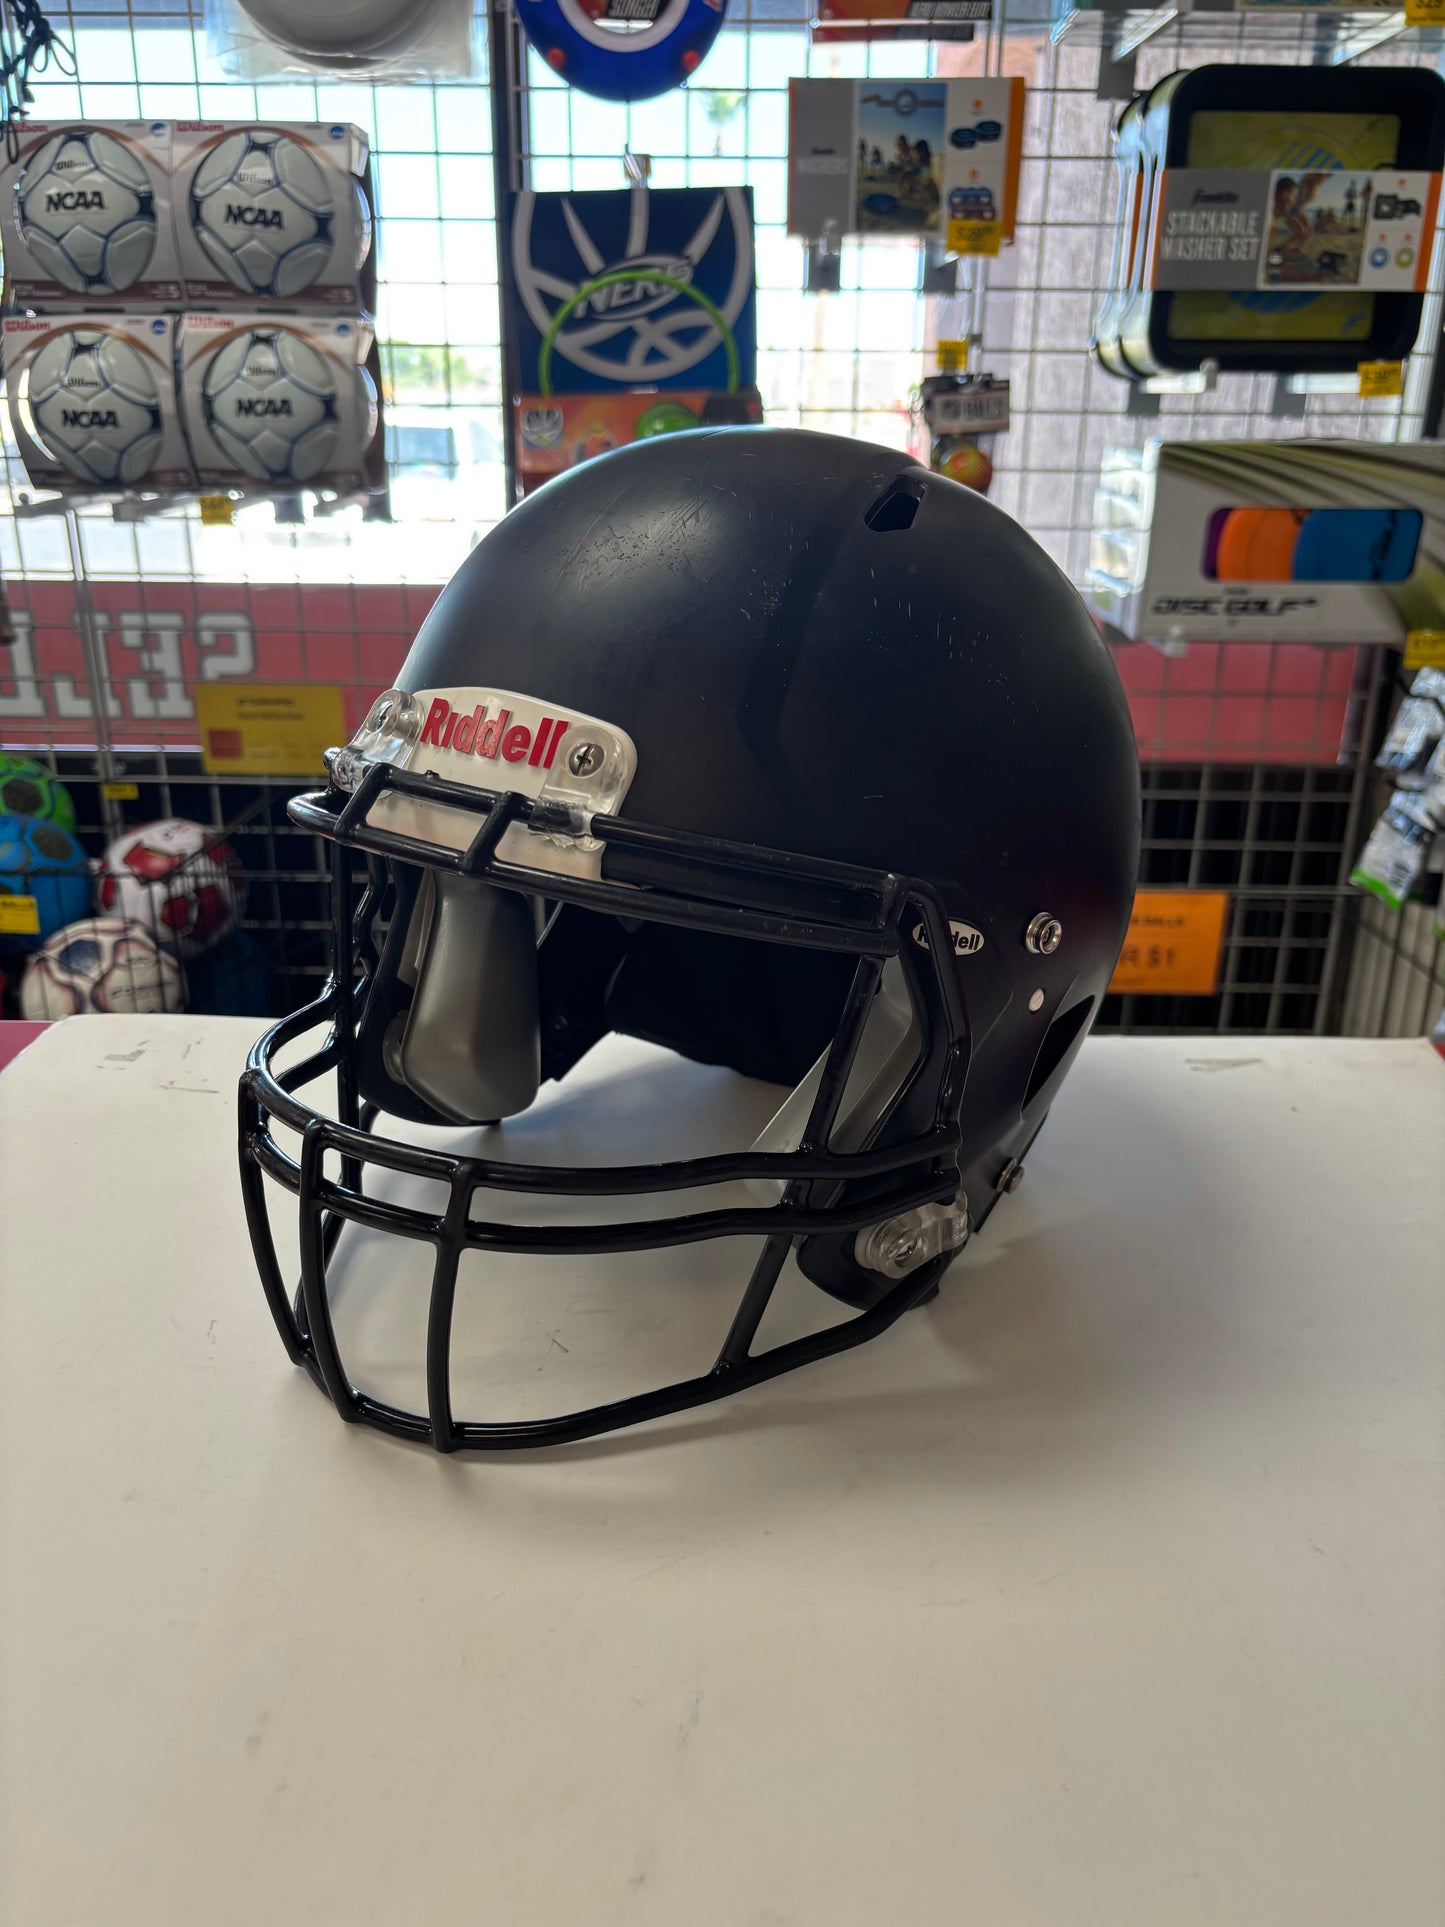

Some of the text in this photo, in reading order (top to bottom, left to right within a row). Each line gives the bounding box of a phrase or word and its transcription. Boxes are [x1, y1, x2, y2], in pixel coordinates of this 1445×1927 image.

[46, 192, 105, 212] NCAA
[225, 204, 283, 230] NCAA
[1165, 210, 1260, 236] STACKABLE
[1161, 236, 1261, 261] WASHER SET
[61, 409, 119, 428] NCAA
[236, 398, 294, 418] NCAA
[420, 697, 570, 770] Riddell
[916, 925, 981, 951] Rdell
